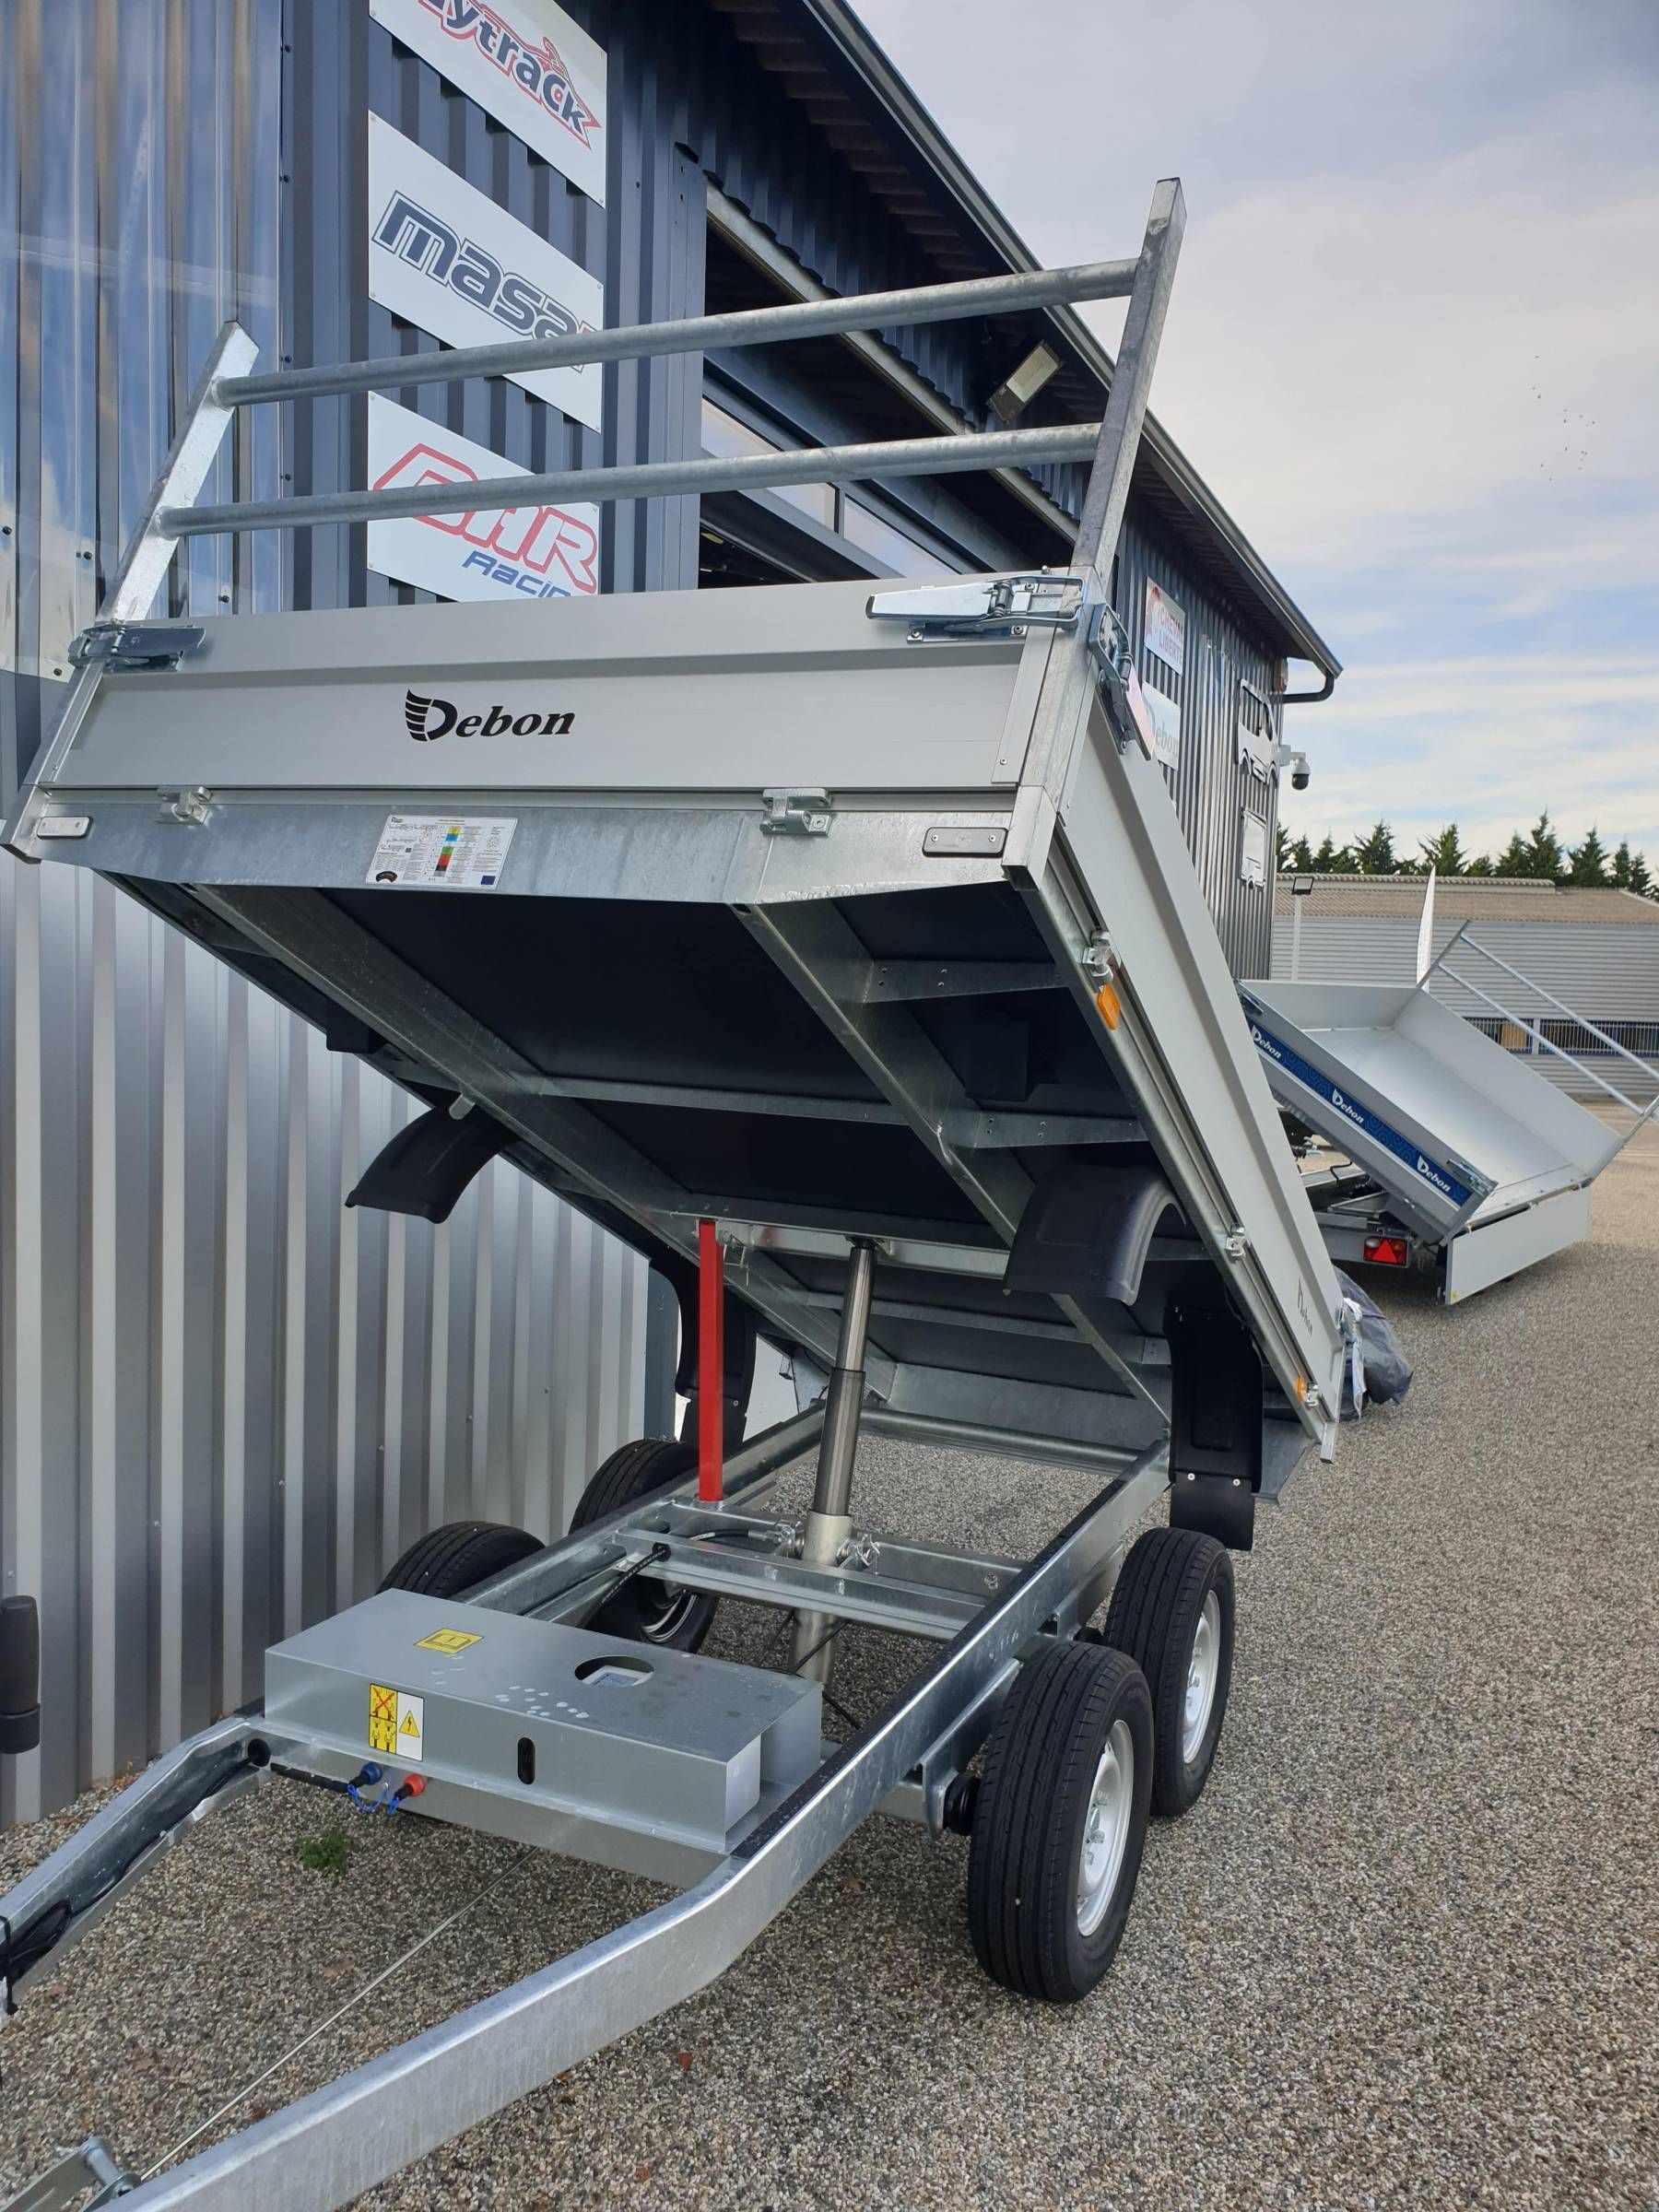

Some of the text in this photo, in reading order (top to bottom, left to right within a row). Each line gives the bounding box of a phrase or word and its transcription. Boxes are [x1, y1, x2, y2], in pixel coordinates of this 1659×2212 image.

[422, 0, 588, 135] ytrack
[405, 688, 576, 742] Debon
[1251, 1024, 1282, 1059] Debon
[1332, 1088, 1365, 1124] Debon
[1417, 1155, 1452, 1193] Debon
